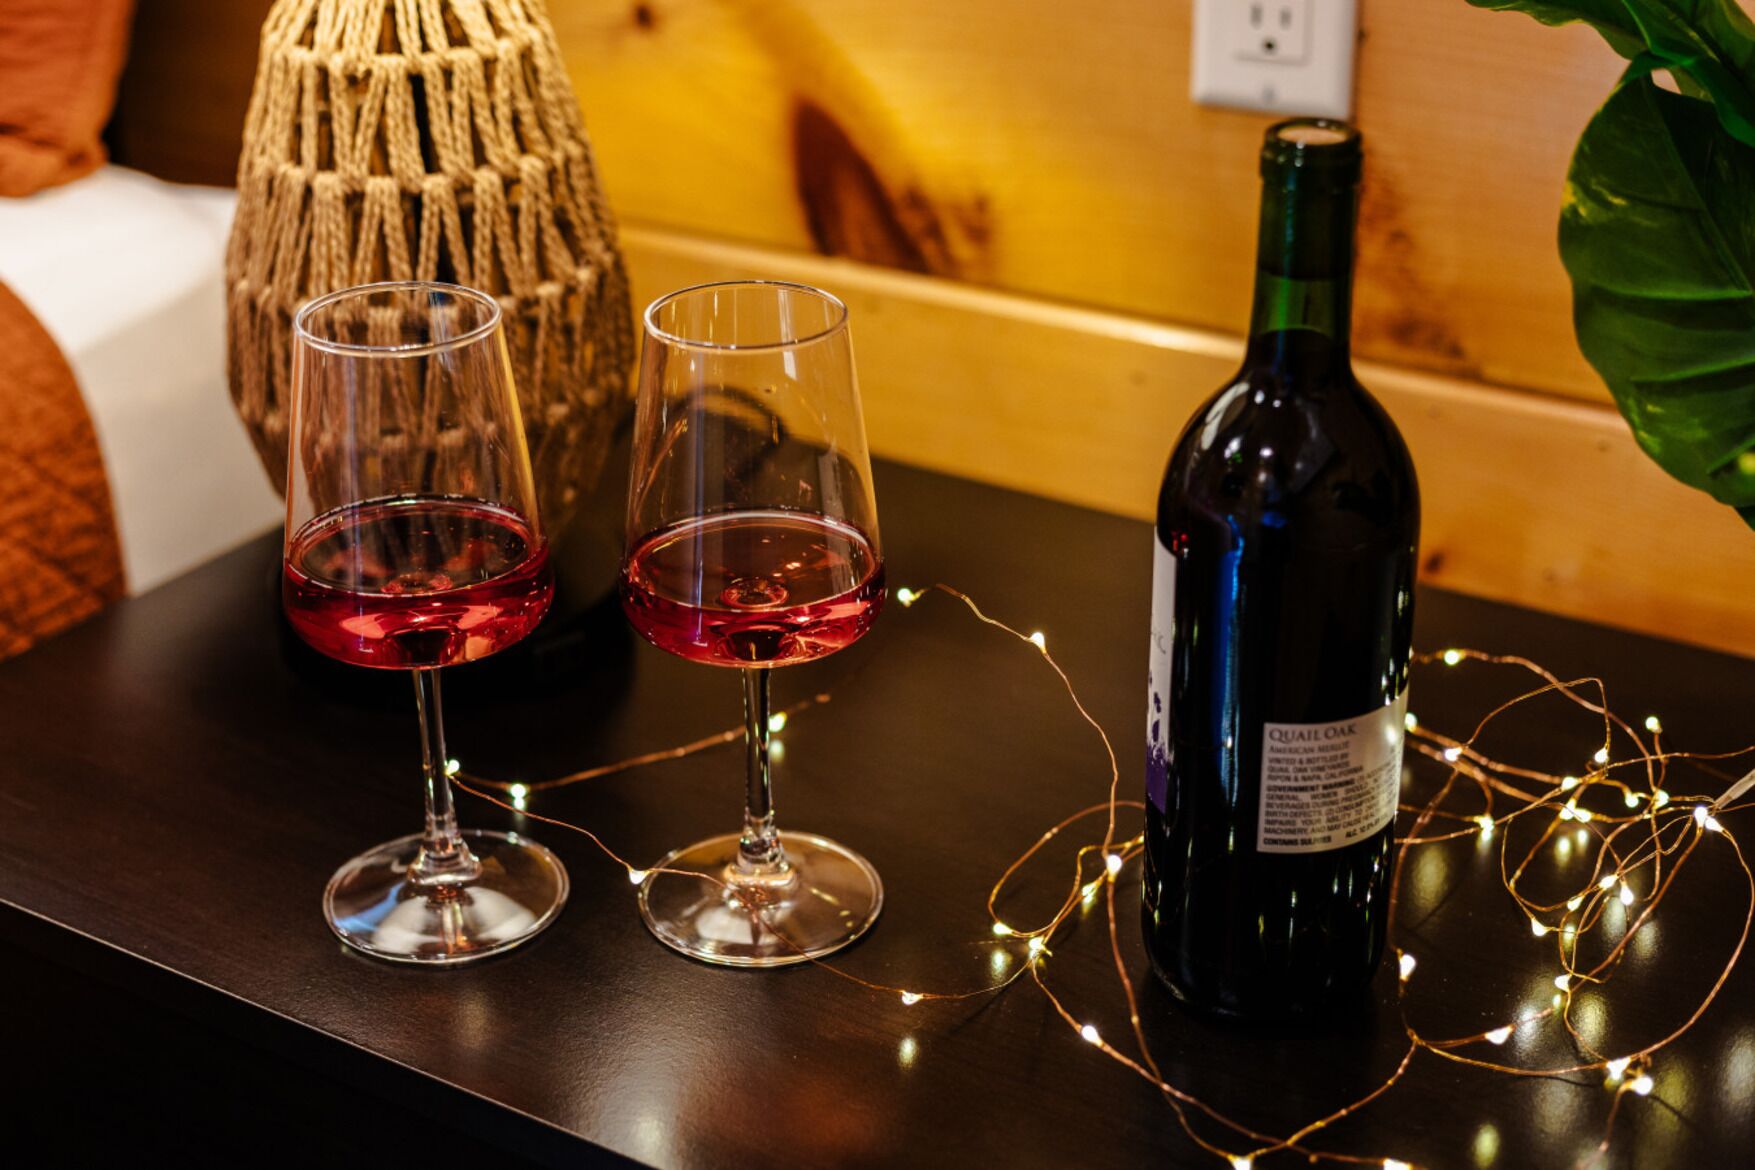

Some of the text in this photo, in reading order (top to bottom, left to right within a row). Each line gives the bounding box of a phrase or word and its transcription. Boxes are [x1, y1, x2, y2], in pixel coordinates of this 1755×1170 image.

[1269, 724, 1357, 744] QUAIL OAK
[1268, 757, 1296, 765] VINTED
